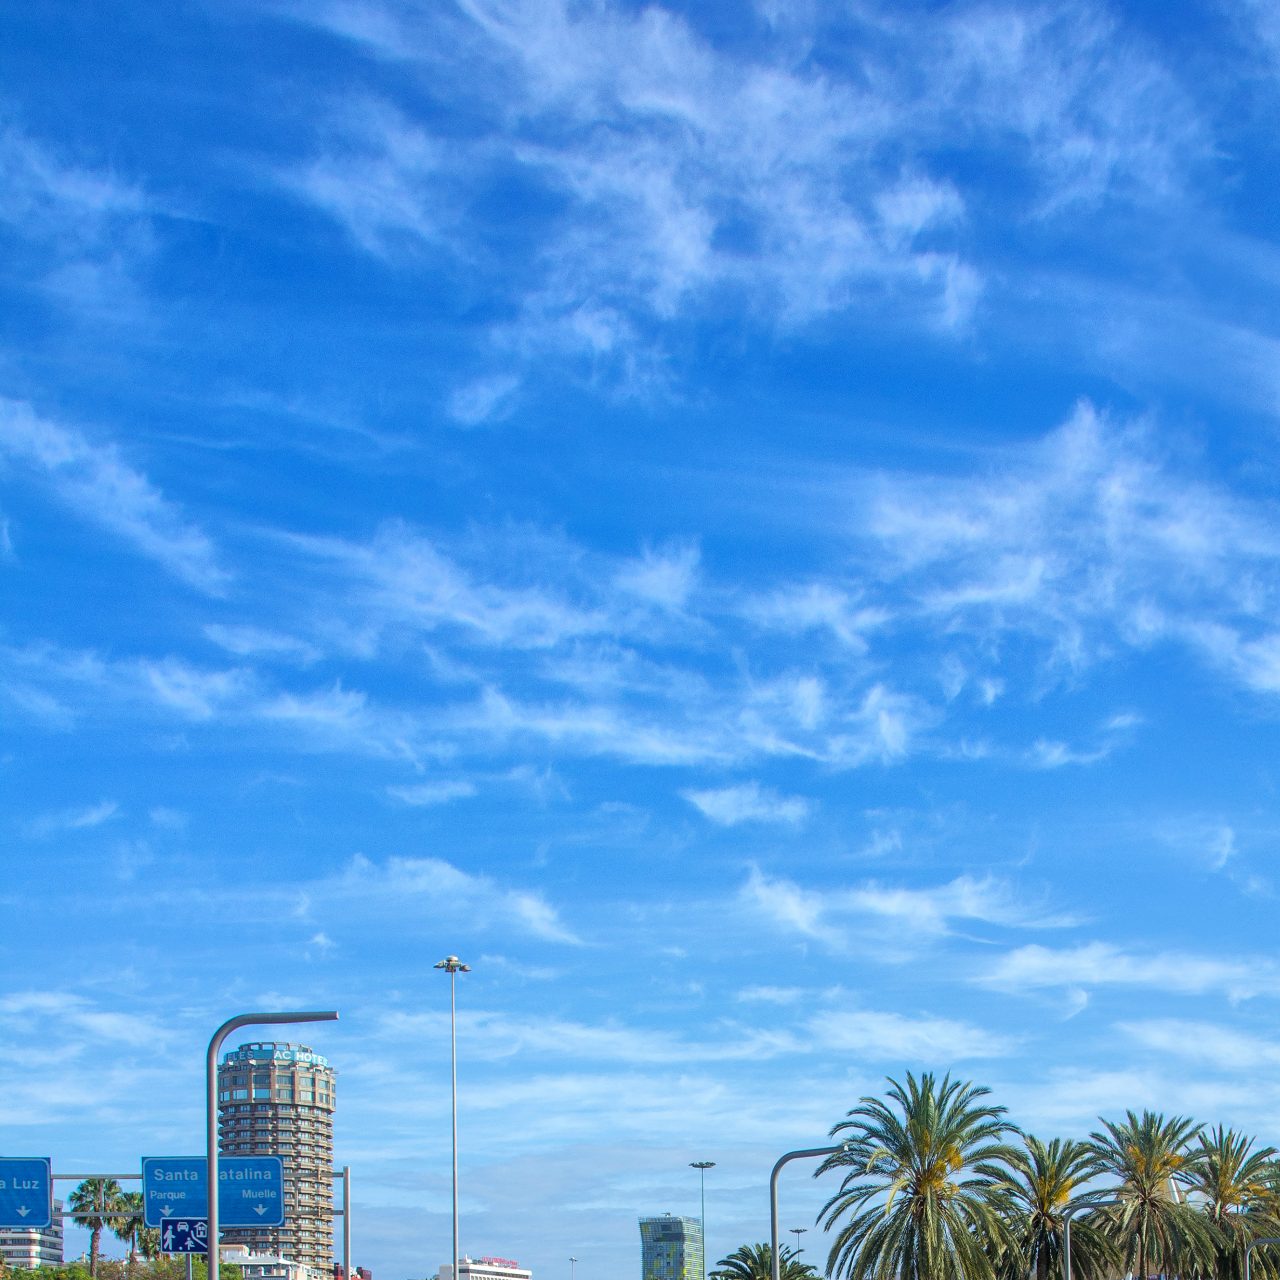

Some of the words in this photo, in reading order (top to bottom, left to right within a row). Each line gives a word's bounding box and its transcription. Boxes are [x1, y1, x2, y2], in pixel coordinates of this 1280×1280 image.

[274, 1051, 291, 1060] AC
[154, 1168, 198, 1181] Santa
[219, 1168, 272, 1180] atalina
[13, 1176, 40, 1189] Luz
[150, 1190, 186, 1200] Parque
[242, 1189, 277, 1198] Muelle
